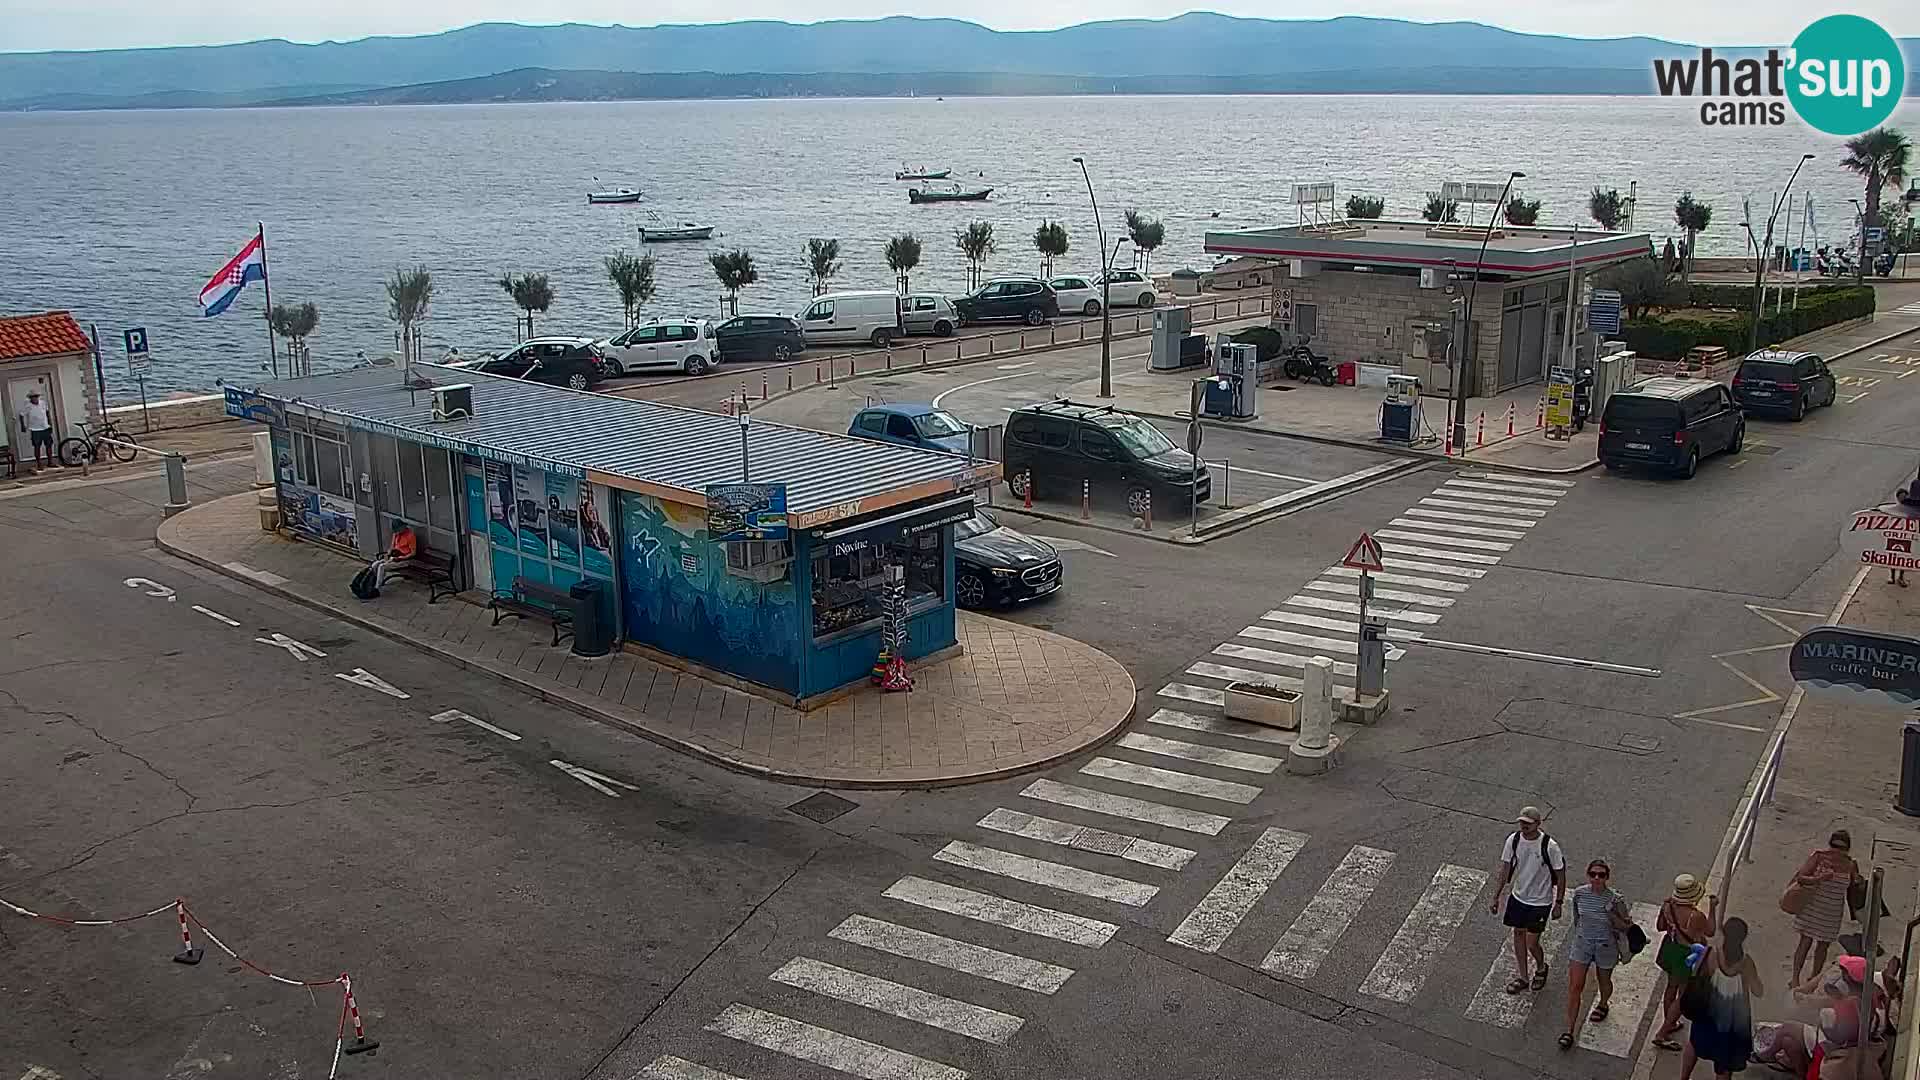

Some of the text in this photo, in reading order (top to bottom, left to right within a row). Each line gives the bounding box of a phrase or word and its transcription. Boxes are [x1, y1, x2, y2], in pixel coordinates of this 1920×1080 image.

[130, 331, 142, 350] P
[437, 437, 468, 452] POSTAJA
[478, 446, 582, 478] BUS STATION TICKET OFFICE
[1849, 515, 1920, 533] PIZZE
[1802, 643, 1920, 673] MARINER
[1871, 666, 1899, 681] bar
